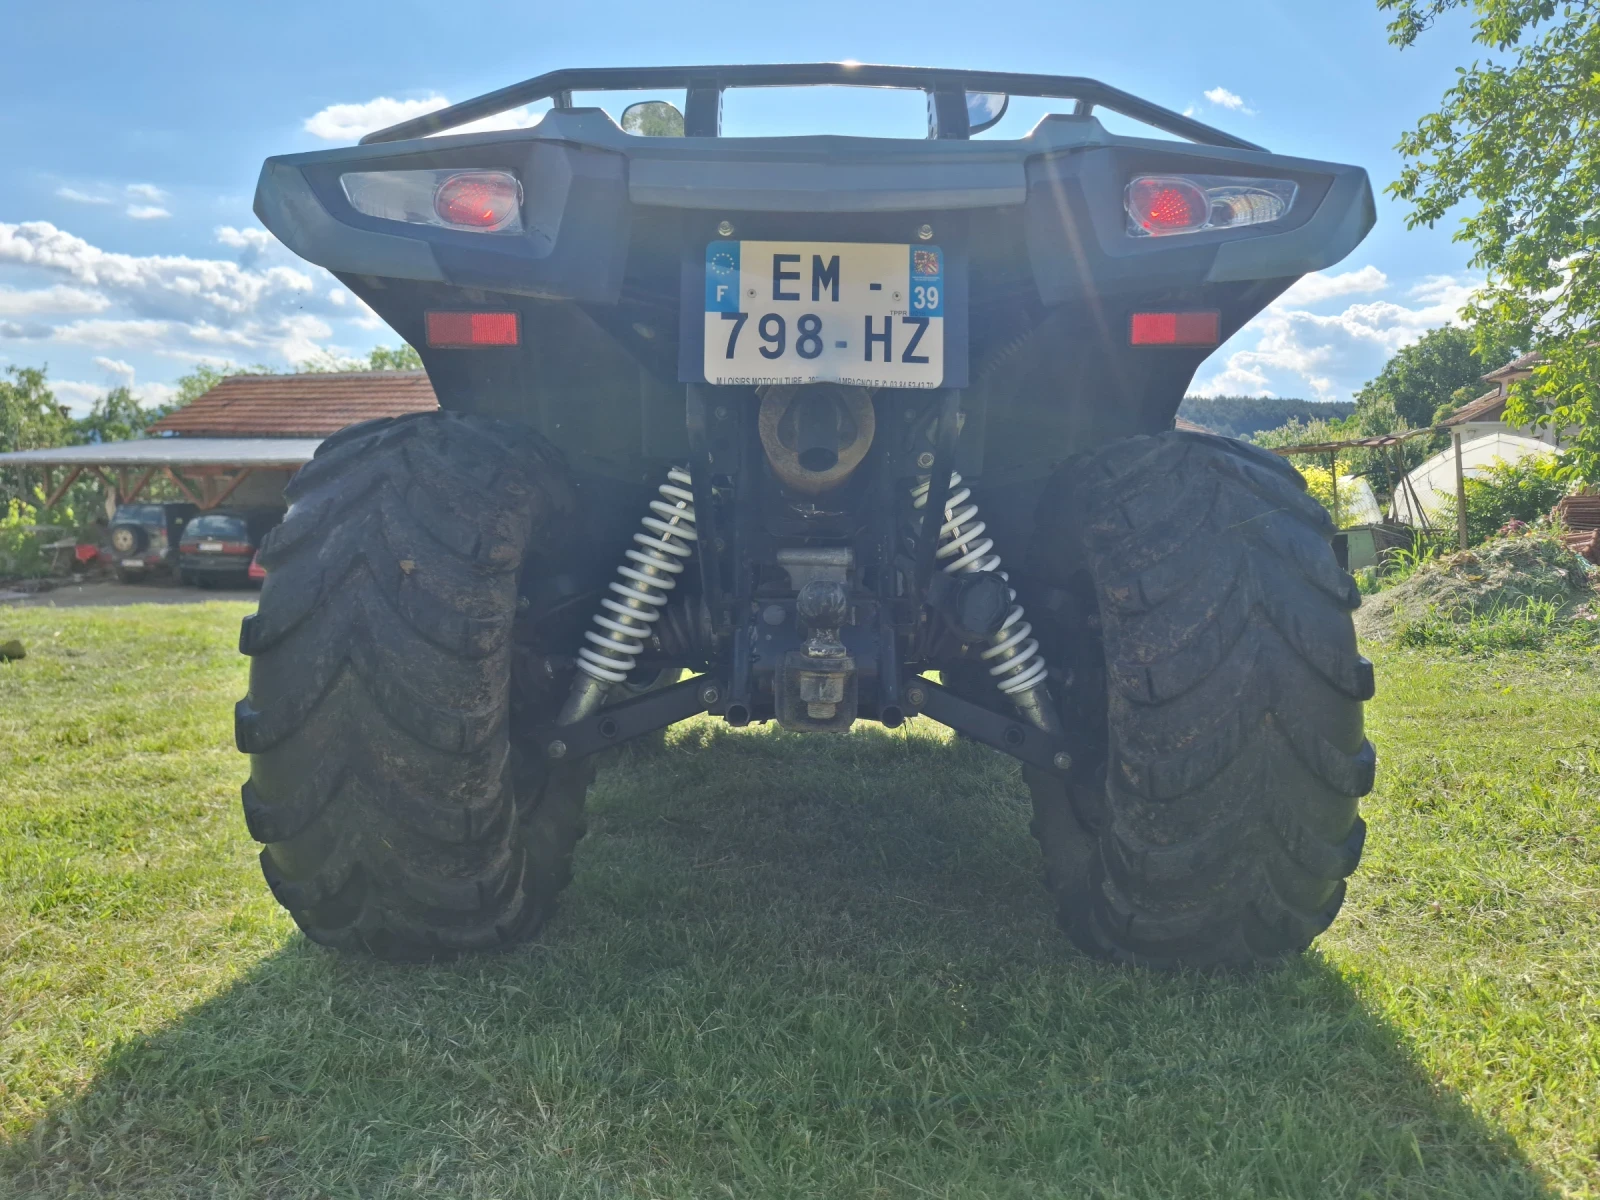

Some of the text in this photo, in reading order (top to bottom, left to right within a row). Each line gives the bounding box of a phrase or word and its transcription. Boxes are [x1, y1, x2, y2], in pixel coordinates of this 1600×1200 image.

[772, 253, 841, 302] EM
[716, 285, 729, 302] F
[913, 286, 939, 310] 39
